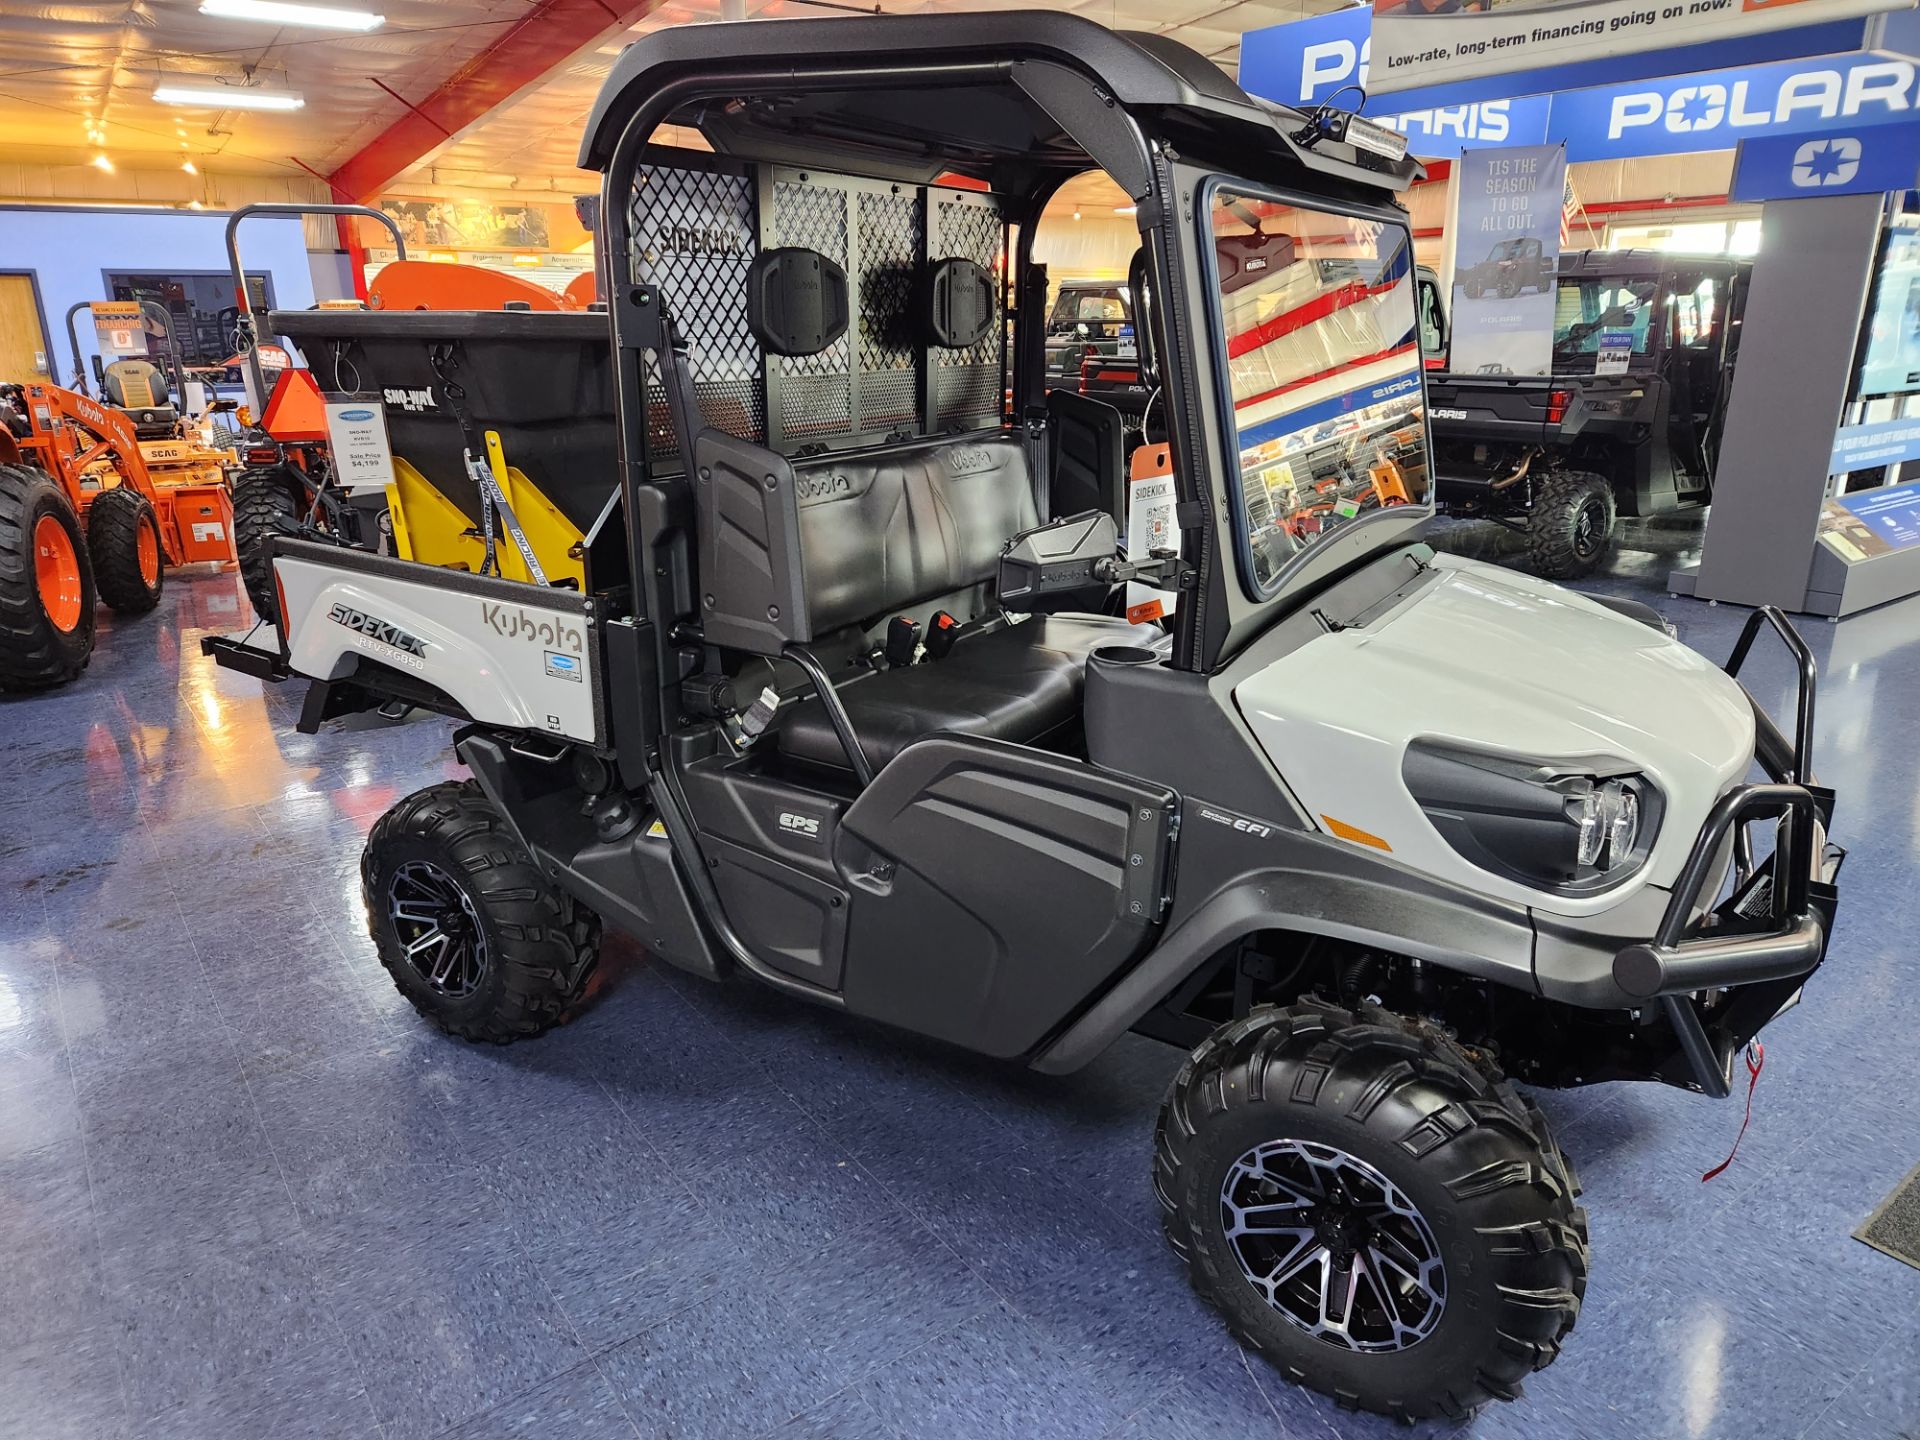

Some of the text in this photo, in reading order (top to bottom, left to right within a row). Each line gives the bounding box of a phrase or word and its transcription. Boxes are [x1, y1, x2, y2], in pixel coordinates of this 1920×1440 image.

[1388, 46, 1452, 69] Low-rate,
[1455, 32, 1526, 61] long-term
[1531, 20, 1605, 46] financing
[1610, 10, 1656, 32] going
[1662, 6, 1683, 20] on
[1608, 61, 1920, 140] POLAR
[1488, 158, 1538, 176] TIS THE
[1486, 176, 1537, 195] SEASON
[1491, 195, 1529, 213] TO GO
[1480, 213, 1536, 232] ALL OUT.
[383, 387, 439, 407] SNO-WAY
[76, 399, 105, 425] Kubota
[151, 450, 179, 458] SCAG
[1135, 483, 1167, 500] SIDEKICK
[513, 528, 539, 568] RACING
[327, 602, 433, 659] SIDEKICK
[482, 602, 583, 653] Kubota
[358, 636, 425, 671] RTV-XG850
[779, 812, 820, 833] EPS
[1232, 819, 1271, 838] EFI
